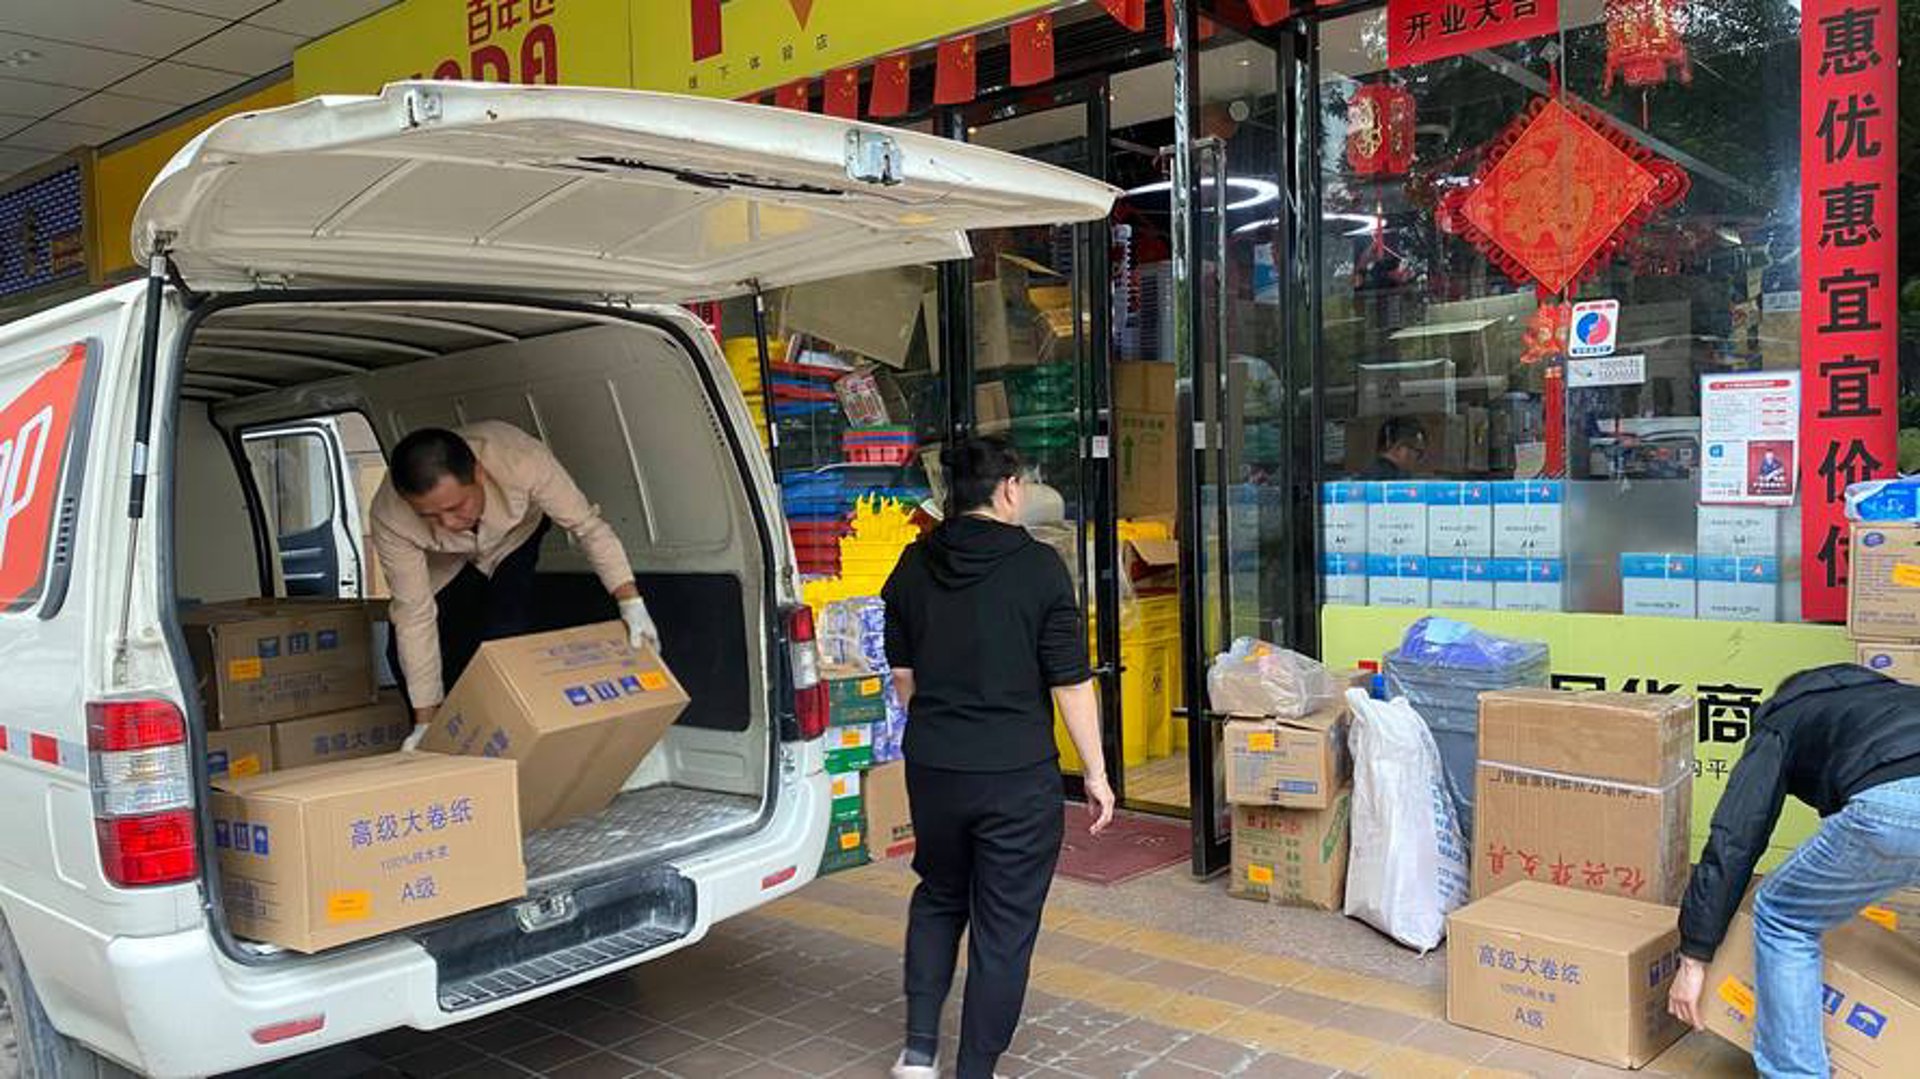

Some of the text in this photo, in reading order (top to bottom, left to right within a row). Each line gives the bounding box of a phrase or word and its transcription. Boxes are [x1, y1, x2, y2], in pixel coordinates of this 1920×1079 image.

[350, 796, 474, 849] 高级大卷纸
[401, 876, 438, 903] A级
[1478, 943, 1582, 985] 高级大卷纸
[1514, 1006, 1544, 1030] A级
